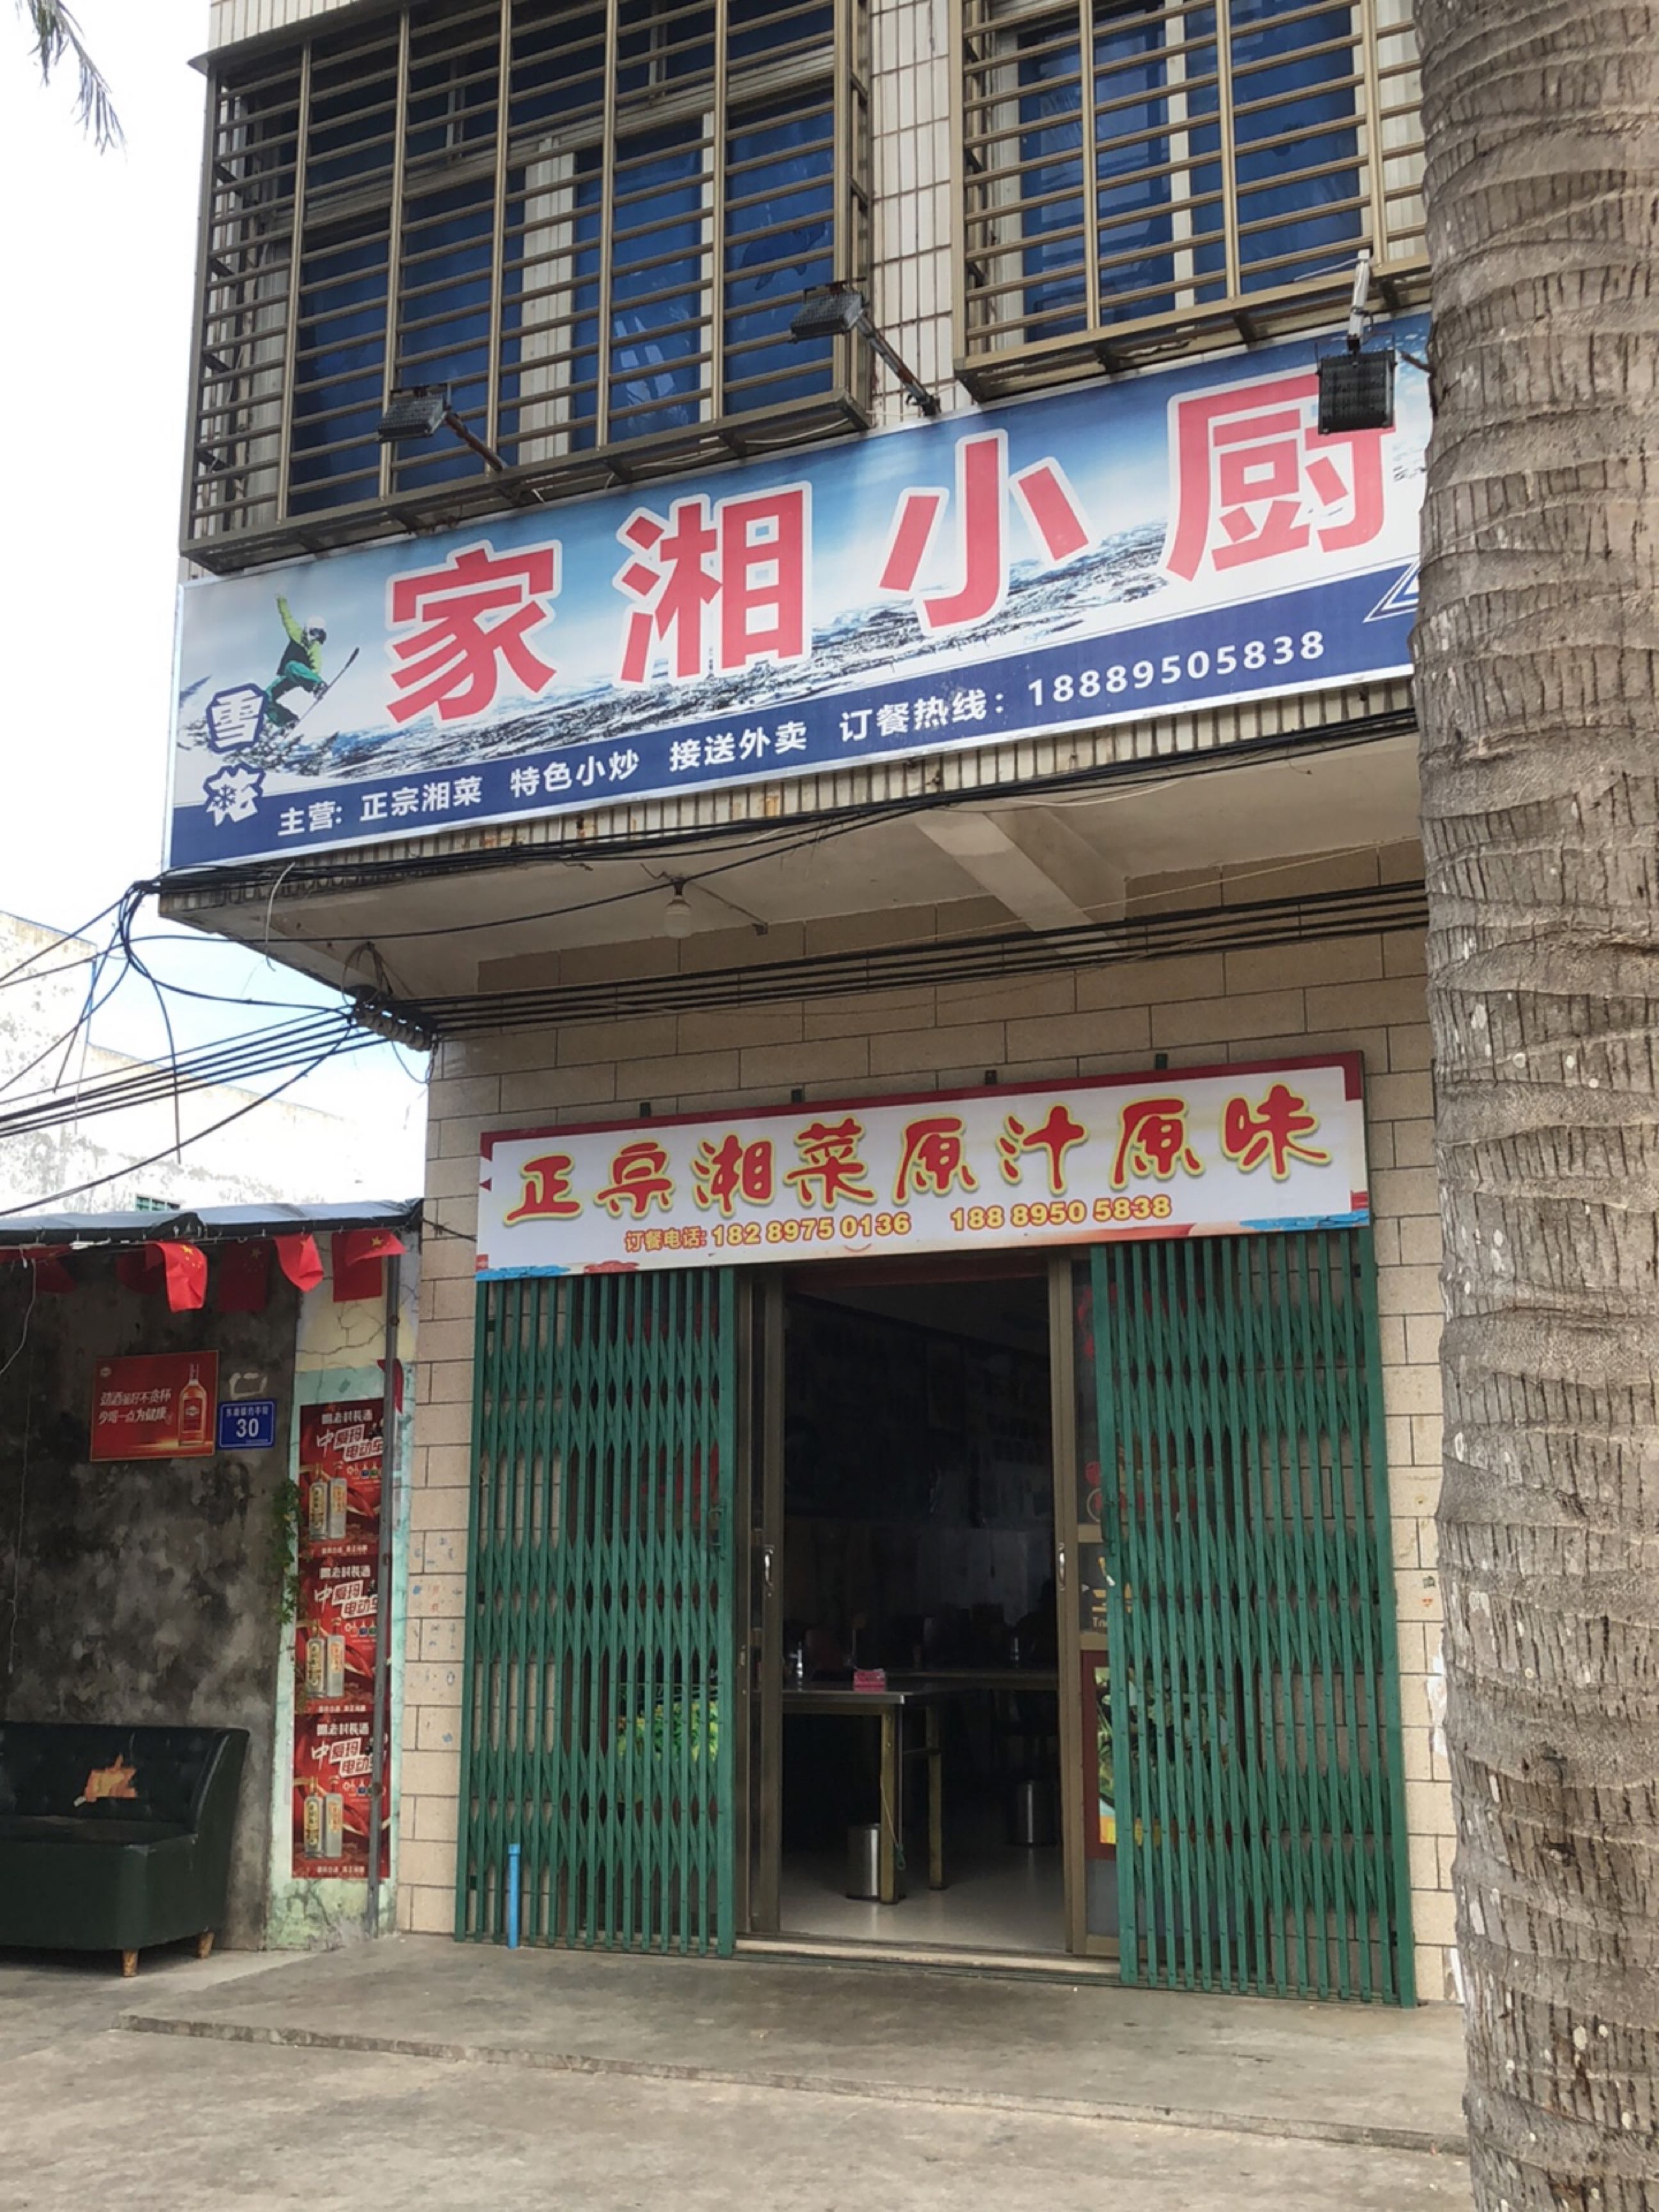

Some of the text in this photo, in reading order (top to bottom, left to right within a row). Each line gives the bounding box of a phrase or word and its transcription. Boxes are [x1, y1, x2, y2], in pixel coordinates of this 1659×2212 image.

[386, 373, 1396, 723] 家湘小厨
[360, 776, 481, 821] 正宗湘菜
[510, 751, 639, 797] 特色小炒
[669, 723, 807, 769] 接送外卖
[840, 689, 1004, 743] 订餐热线:
[1027, 629, 1326, 707] 18889505838
[503, 1083, 1332, 1226] 正宗湘菜原汁原味
[713, 1225, 760, 1247] 182
[767, 1219, 835, 1242] 8975
[840, 1212, 911, 1238] 0136
[950, 1205, 1004, 1231] 188
[1011, 1199, 1086, 1227] 8950
[1093, 1194, 1173, 1221] 5838
[236, 1418, 260, 1439] 30
